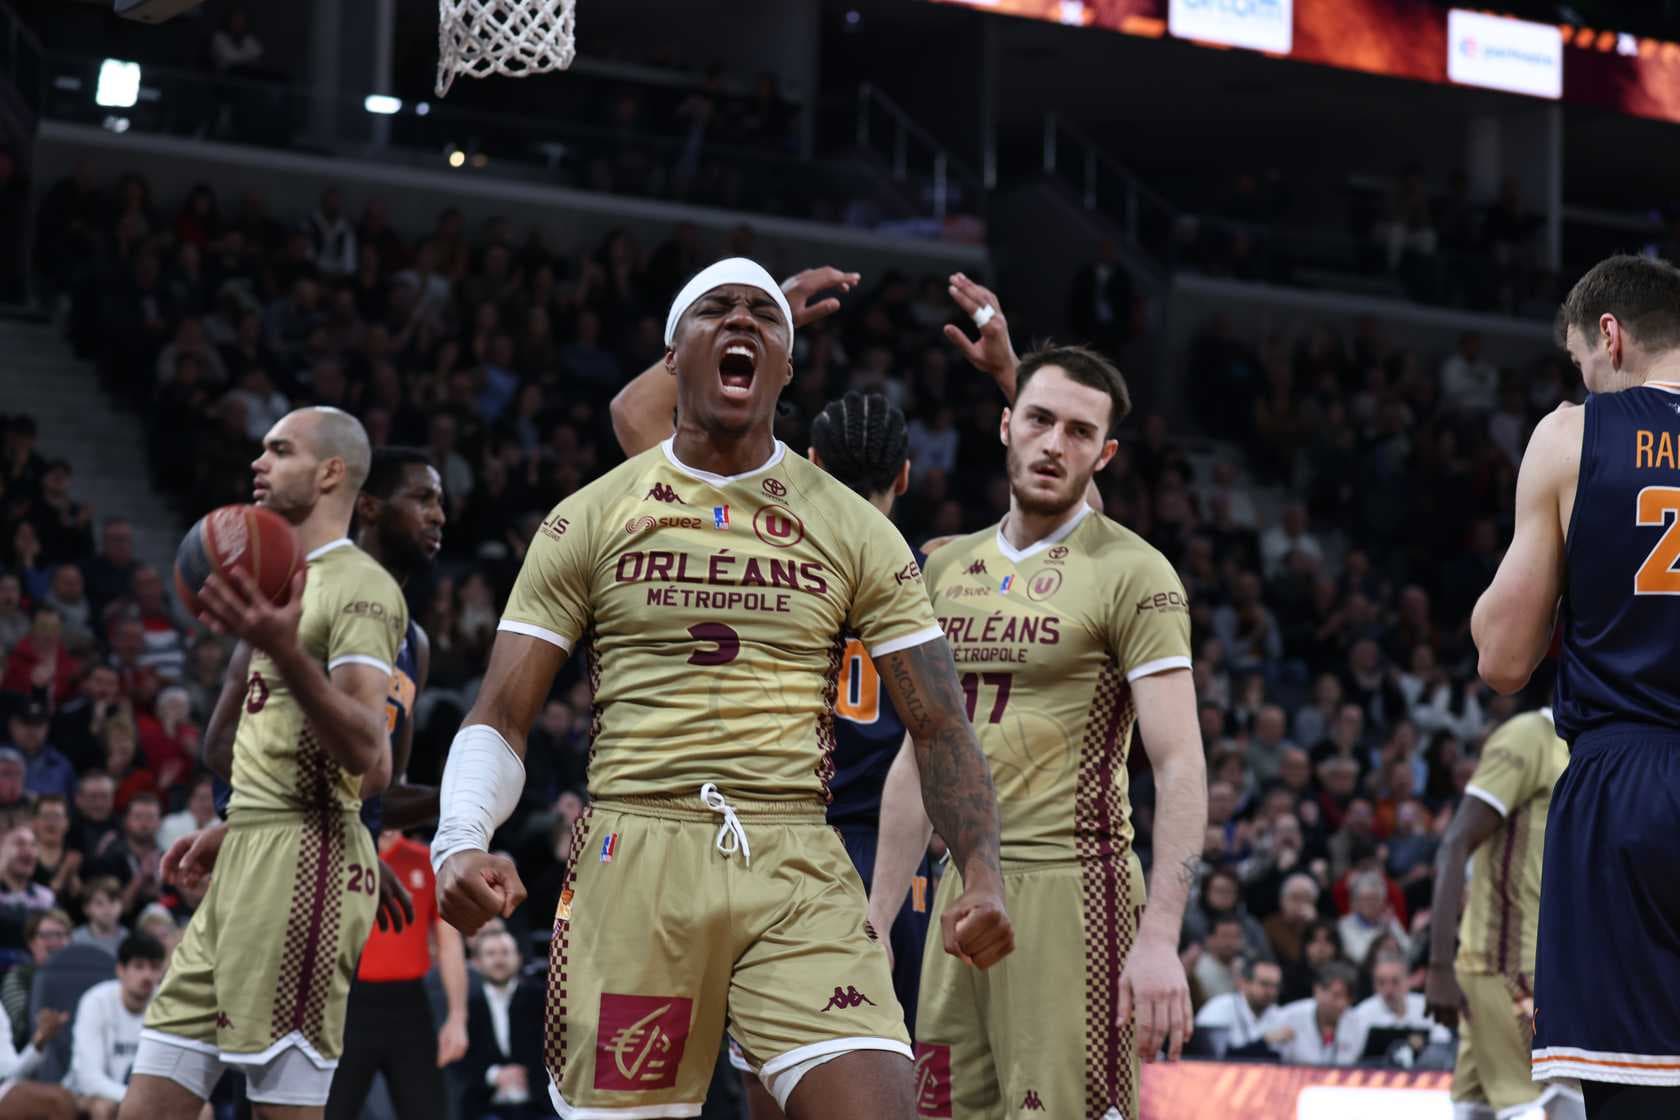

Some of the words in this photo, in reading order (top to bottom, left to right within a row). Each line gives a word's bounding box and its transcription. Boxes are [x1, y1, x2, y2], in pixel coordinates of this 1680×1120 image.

[1635, 430, 1680, 469] RA
[658, 516, 702, 529] suez
[1634, 486, 1680, 595] 2
[615, 549, 828, 594] ORLÉANS
[646, 585, 791, 612] MÉTROPOLE
[952, 647, 1028, 663] ÉTROPOLE
[246, 671, 270, 714] 0
[961, 672, 1013, 724] 17
[347, 863, 376, 896] 20
